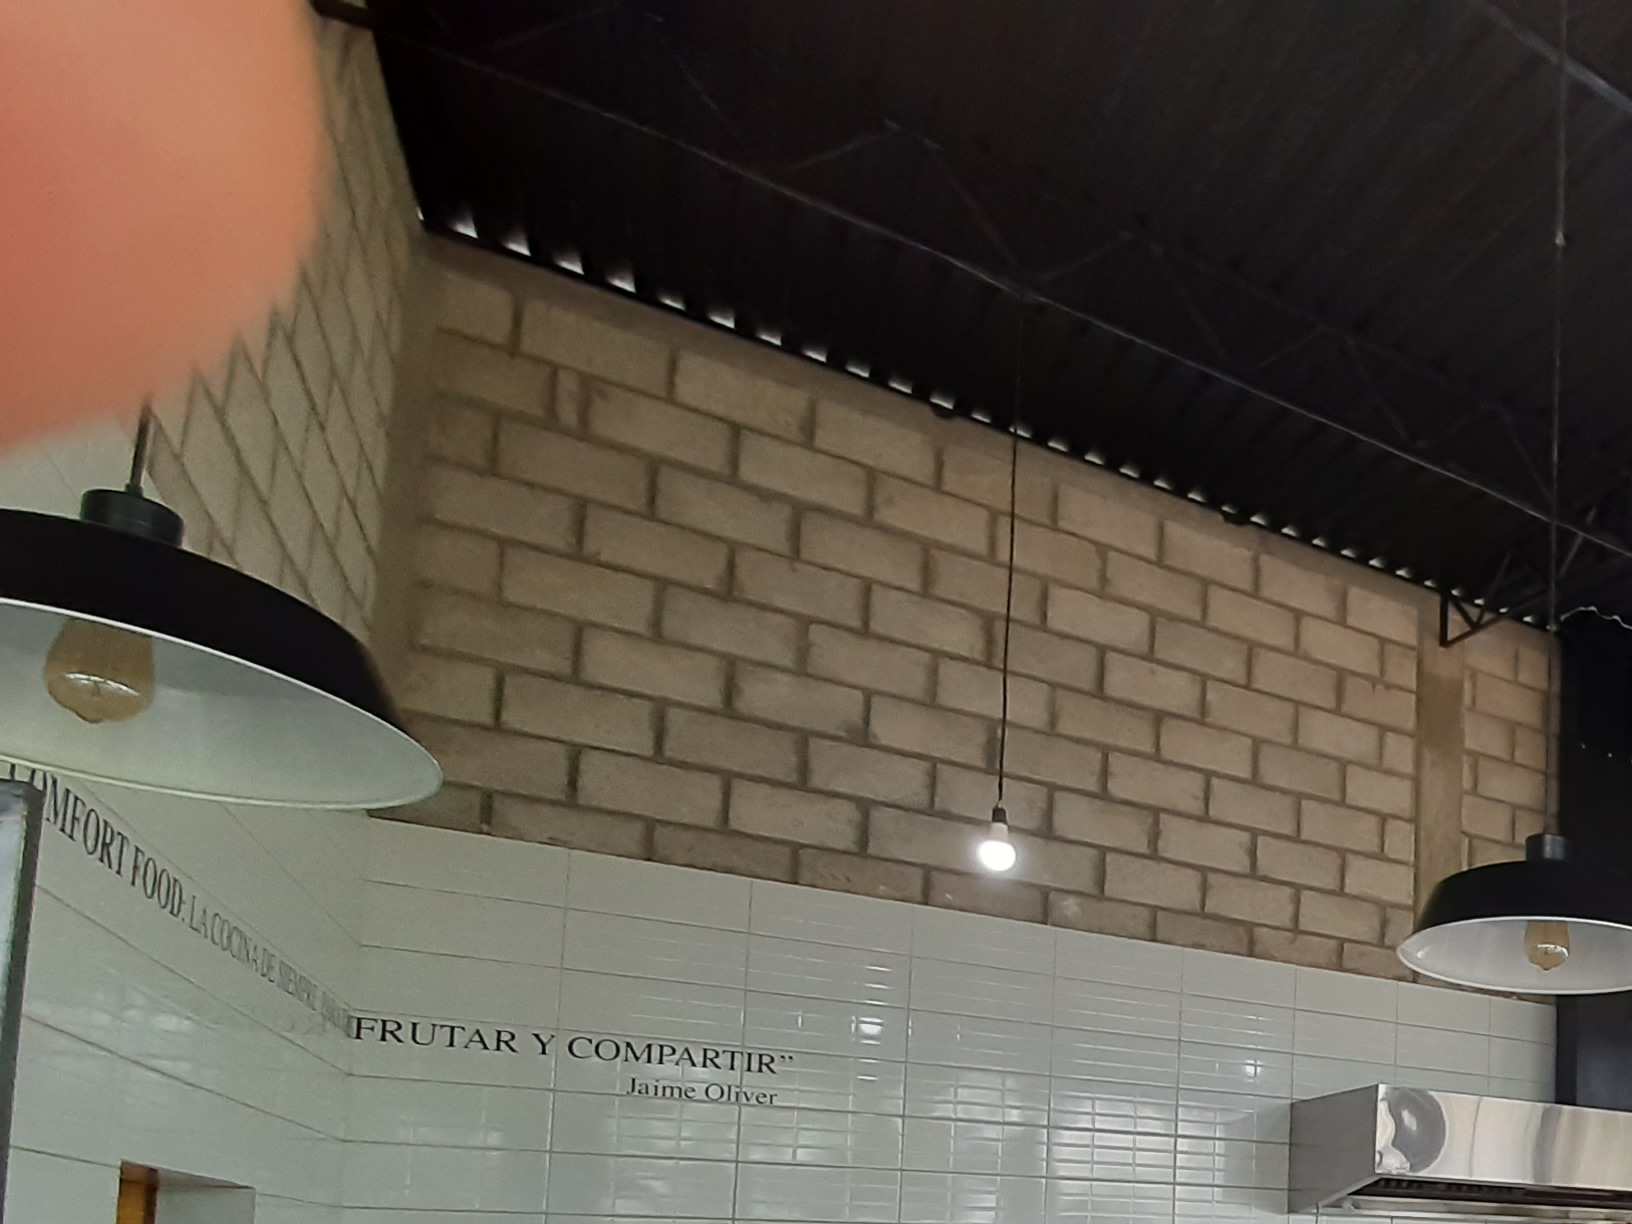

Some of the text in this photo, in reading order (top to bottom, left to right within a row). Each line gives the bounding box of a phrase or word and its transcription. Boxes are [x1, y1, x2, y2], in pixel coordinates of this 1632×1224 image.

[189, 895, 208, 939] LA
[345, 1010, 519, 1054] FRUTAR
[532, 1032, 556, 1056] Y
[626, 1077, 778, 1106] Jaime Oliver
